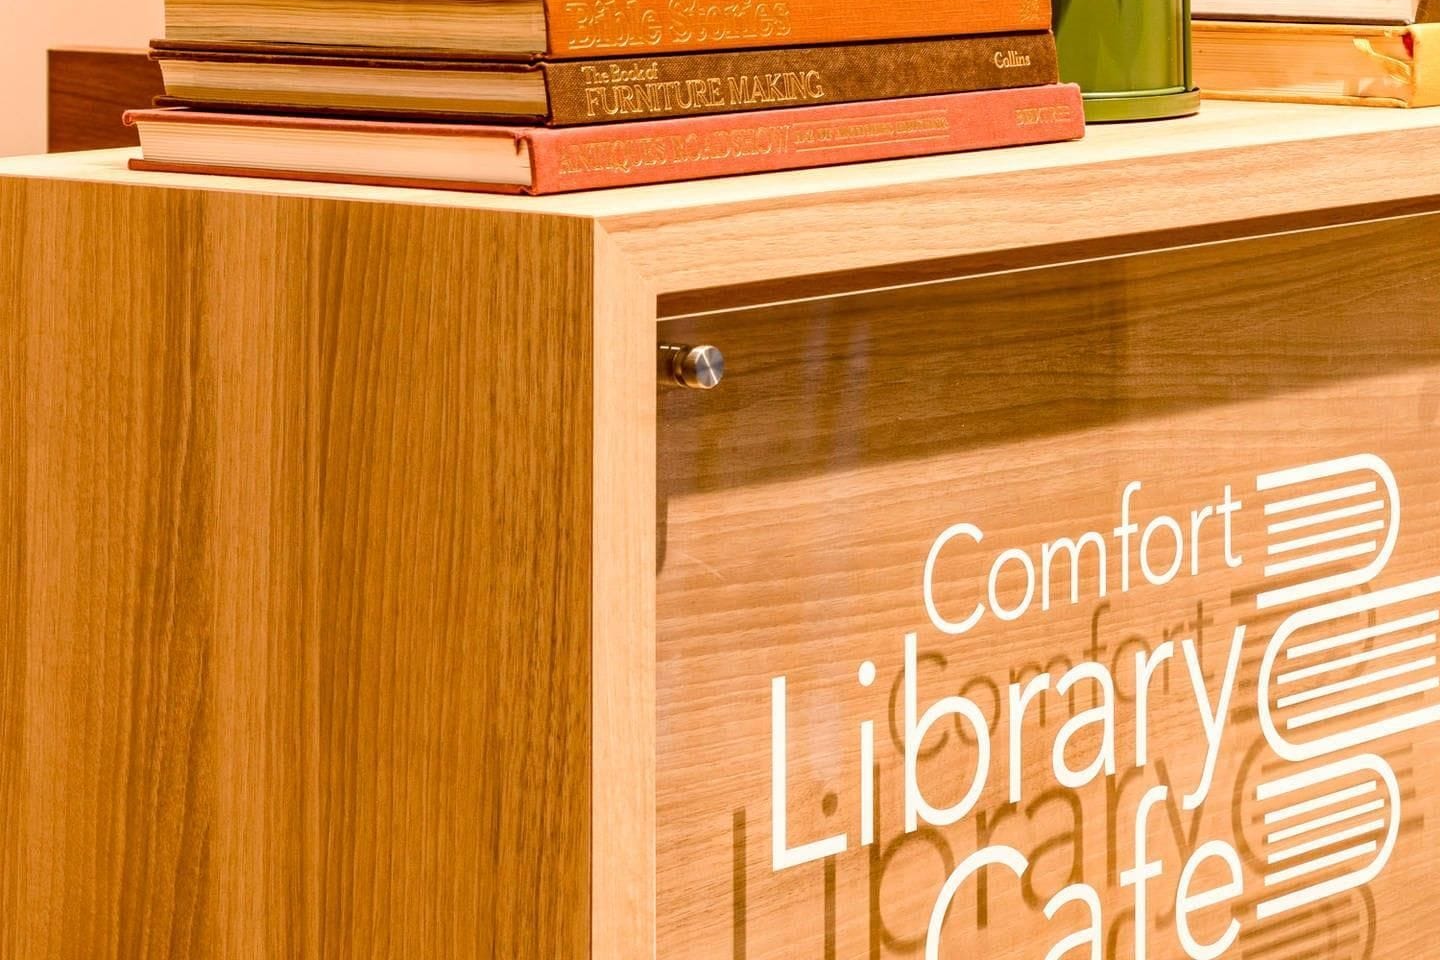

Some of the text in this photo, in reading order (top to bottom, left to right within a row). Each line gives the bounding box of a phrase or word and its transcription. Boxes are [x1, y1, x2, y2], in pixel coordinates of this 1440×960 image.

[565, 0, 662, 50] Bible
[581, 65, 609, 85] The
[611, 63, 645, 83] Book
[994, 50, 1031, 69] Collins
[585, 70, 825, 117] FURNITURE MAKING
[922, 480, 1243, 636] Comfort
[771, 623, 1247, 872] Library
[925, 784, 1246, 960] Cafe
